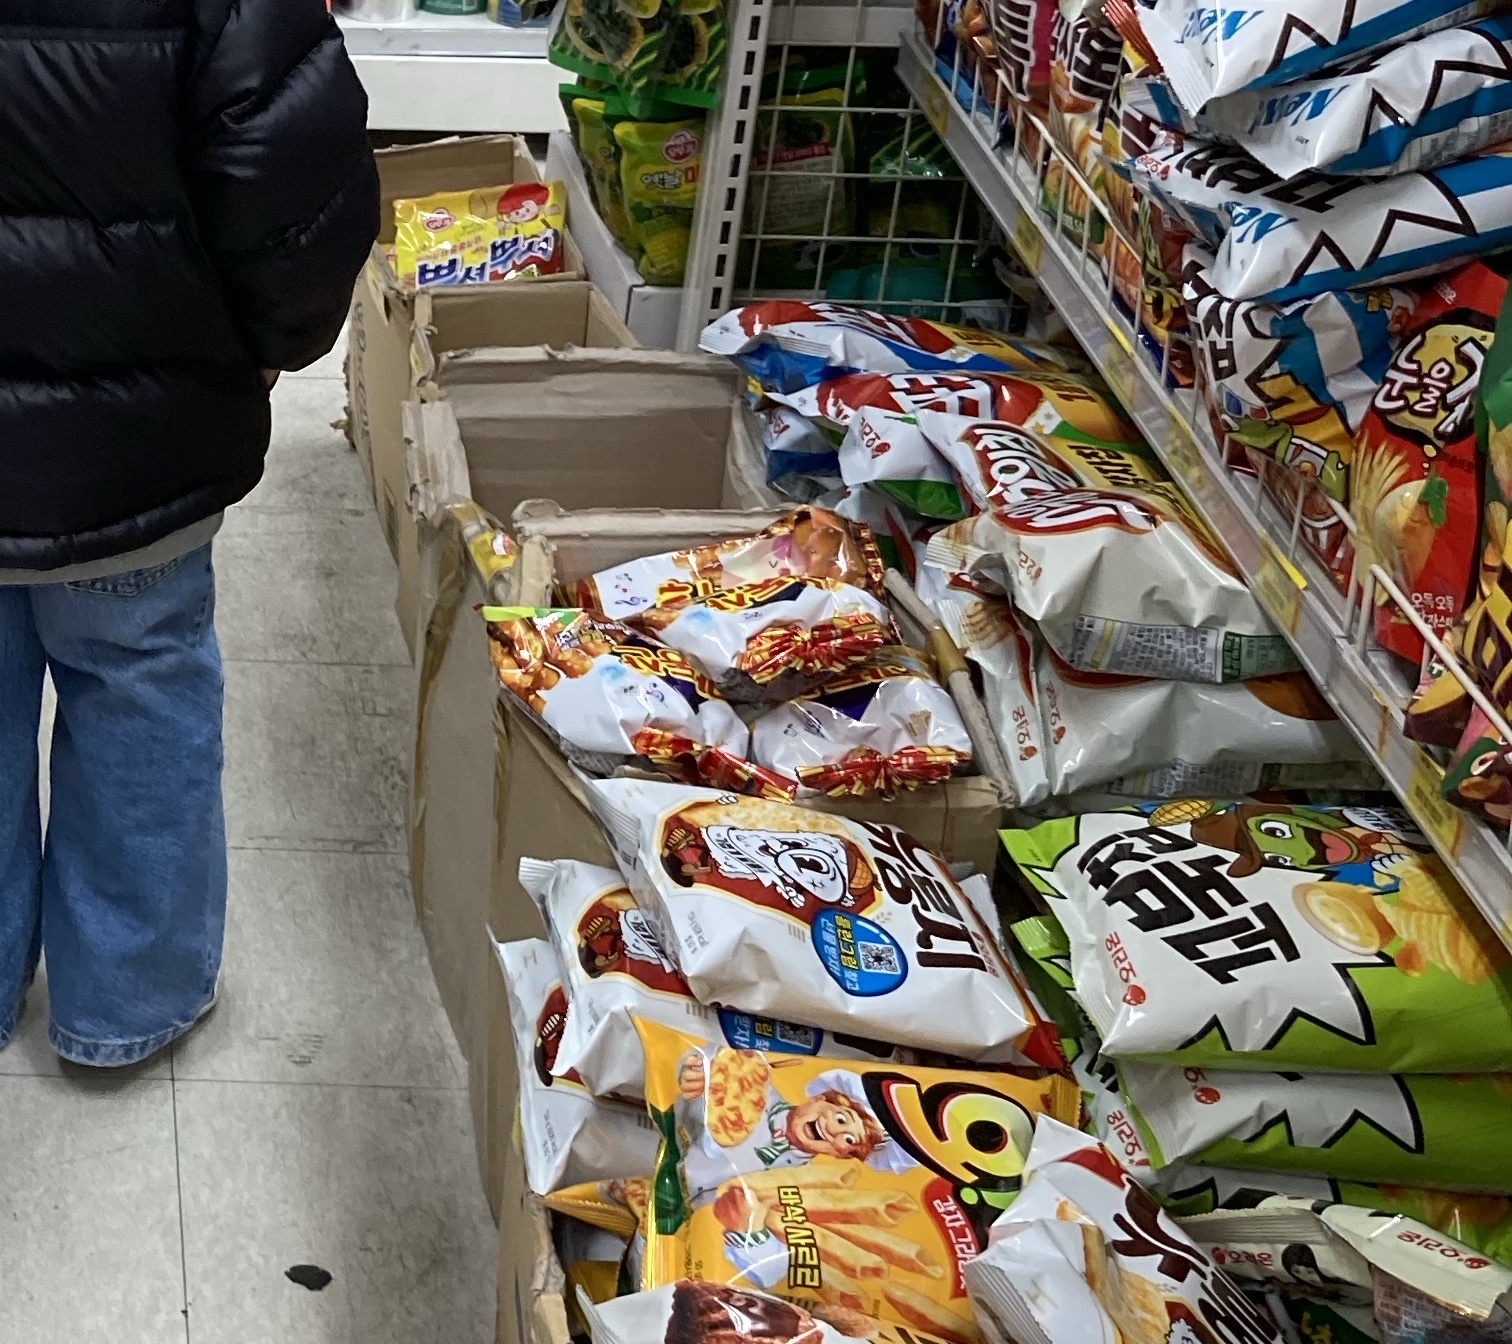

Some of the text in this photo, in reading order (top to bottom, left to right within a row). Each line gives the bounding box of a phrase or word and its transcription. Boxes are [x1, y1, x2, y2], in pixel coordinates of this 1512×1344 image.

[1077, 824, 1302, 986] 꼬북칩
[776, 1184, 822, 1290] 바삭 사르르
